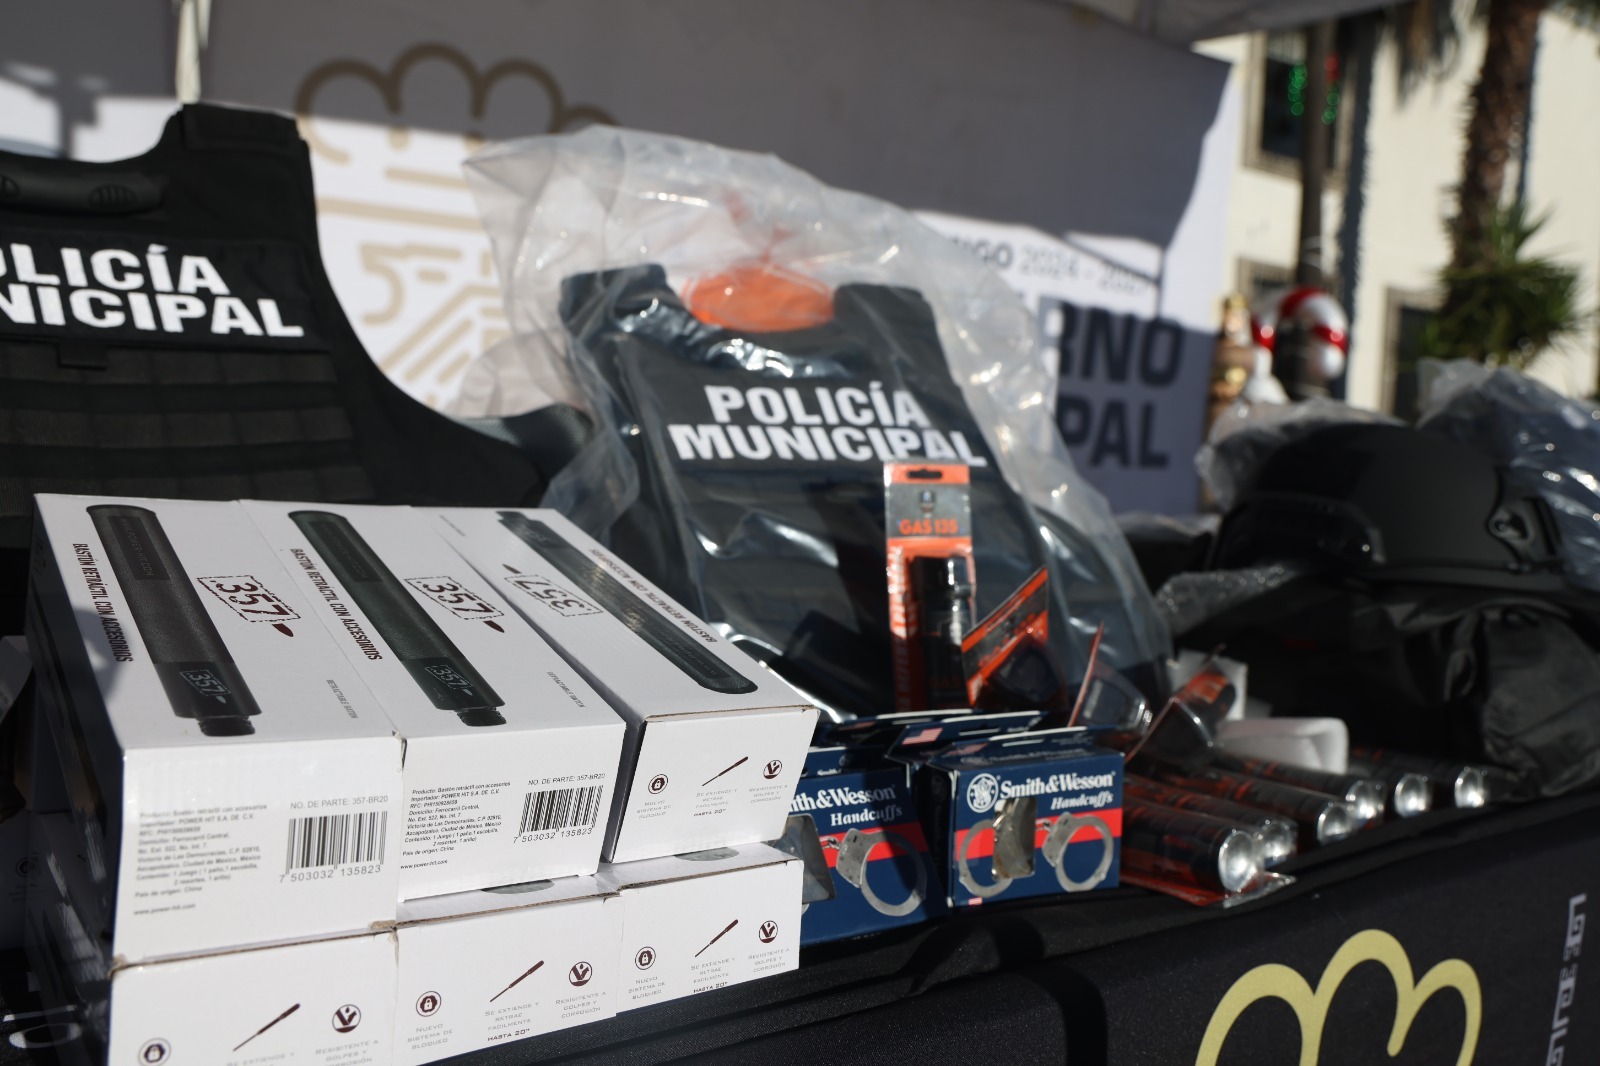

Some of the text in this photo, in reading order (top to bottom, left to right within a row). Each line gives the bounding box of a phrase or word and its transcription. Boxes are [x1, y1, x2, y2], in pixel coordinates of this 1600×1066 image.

[0, 243, 231, 295] LICÍA
[704, 381, 931, 428] POLICÍA
[667, 424, 988, 467] MUNICIPAL
[899, 518, 932, 535] GAS
[73, 543, 134, 662] BASTÓN RETRÁCTIL CON ACCESORIOS
[290, 548, 318, 570] BASTÓN
[306, 571, 340, 602] RETRÁCTIL
[329, 603, 351, 617] CON
[340, 618, 382, 660] ACCESORIOS
[541, 777, 551, 785] DE
[307, 800, 319, 809] DE
[352, 795, 389, 806] 357-BR20
[1050, 790, 1113, 810] Handcuffs
[830, 804, 903, 826] Handcuffs
[521, 832, 556, 843] 503032
[561, 827, 593, 838] 135823
[279, 864, 381, 884] 7 503032 135823
[635, 976, 658, 985] NUEVO
[693, 985, 714, 994] HASTA
[497, 1003, 533, 1014] EXTIENDE
[563, 1001, 591, 1011] GOLPES
[407, 1028, 454, 1043] SISTEMA DE
[415, 1023, 444, 1033] NUEVO
[411, 1037, 449, 1050] BLOQUEO
[487, 1032, 512, 1042] HASTA
